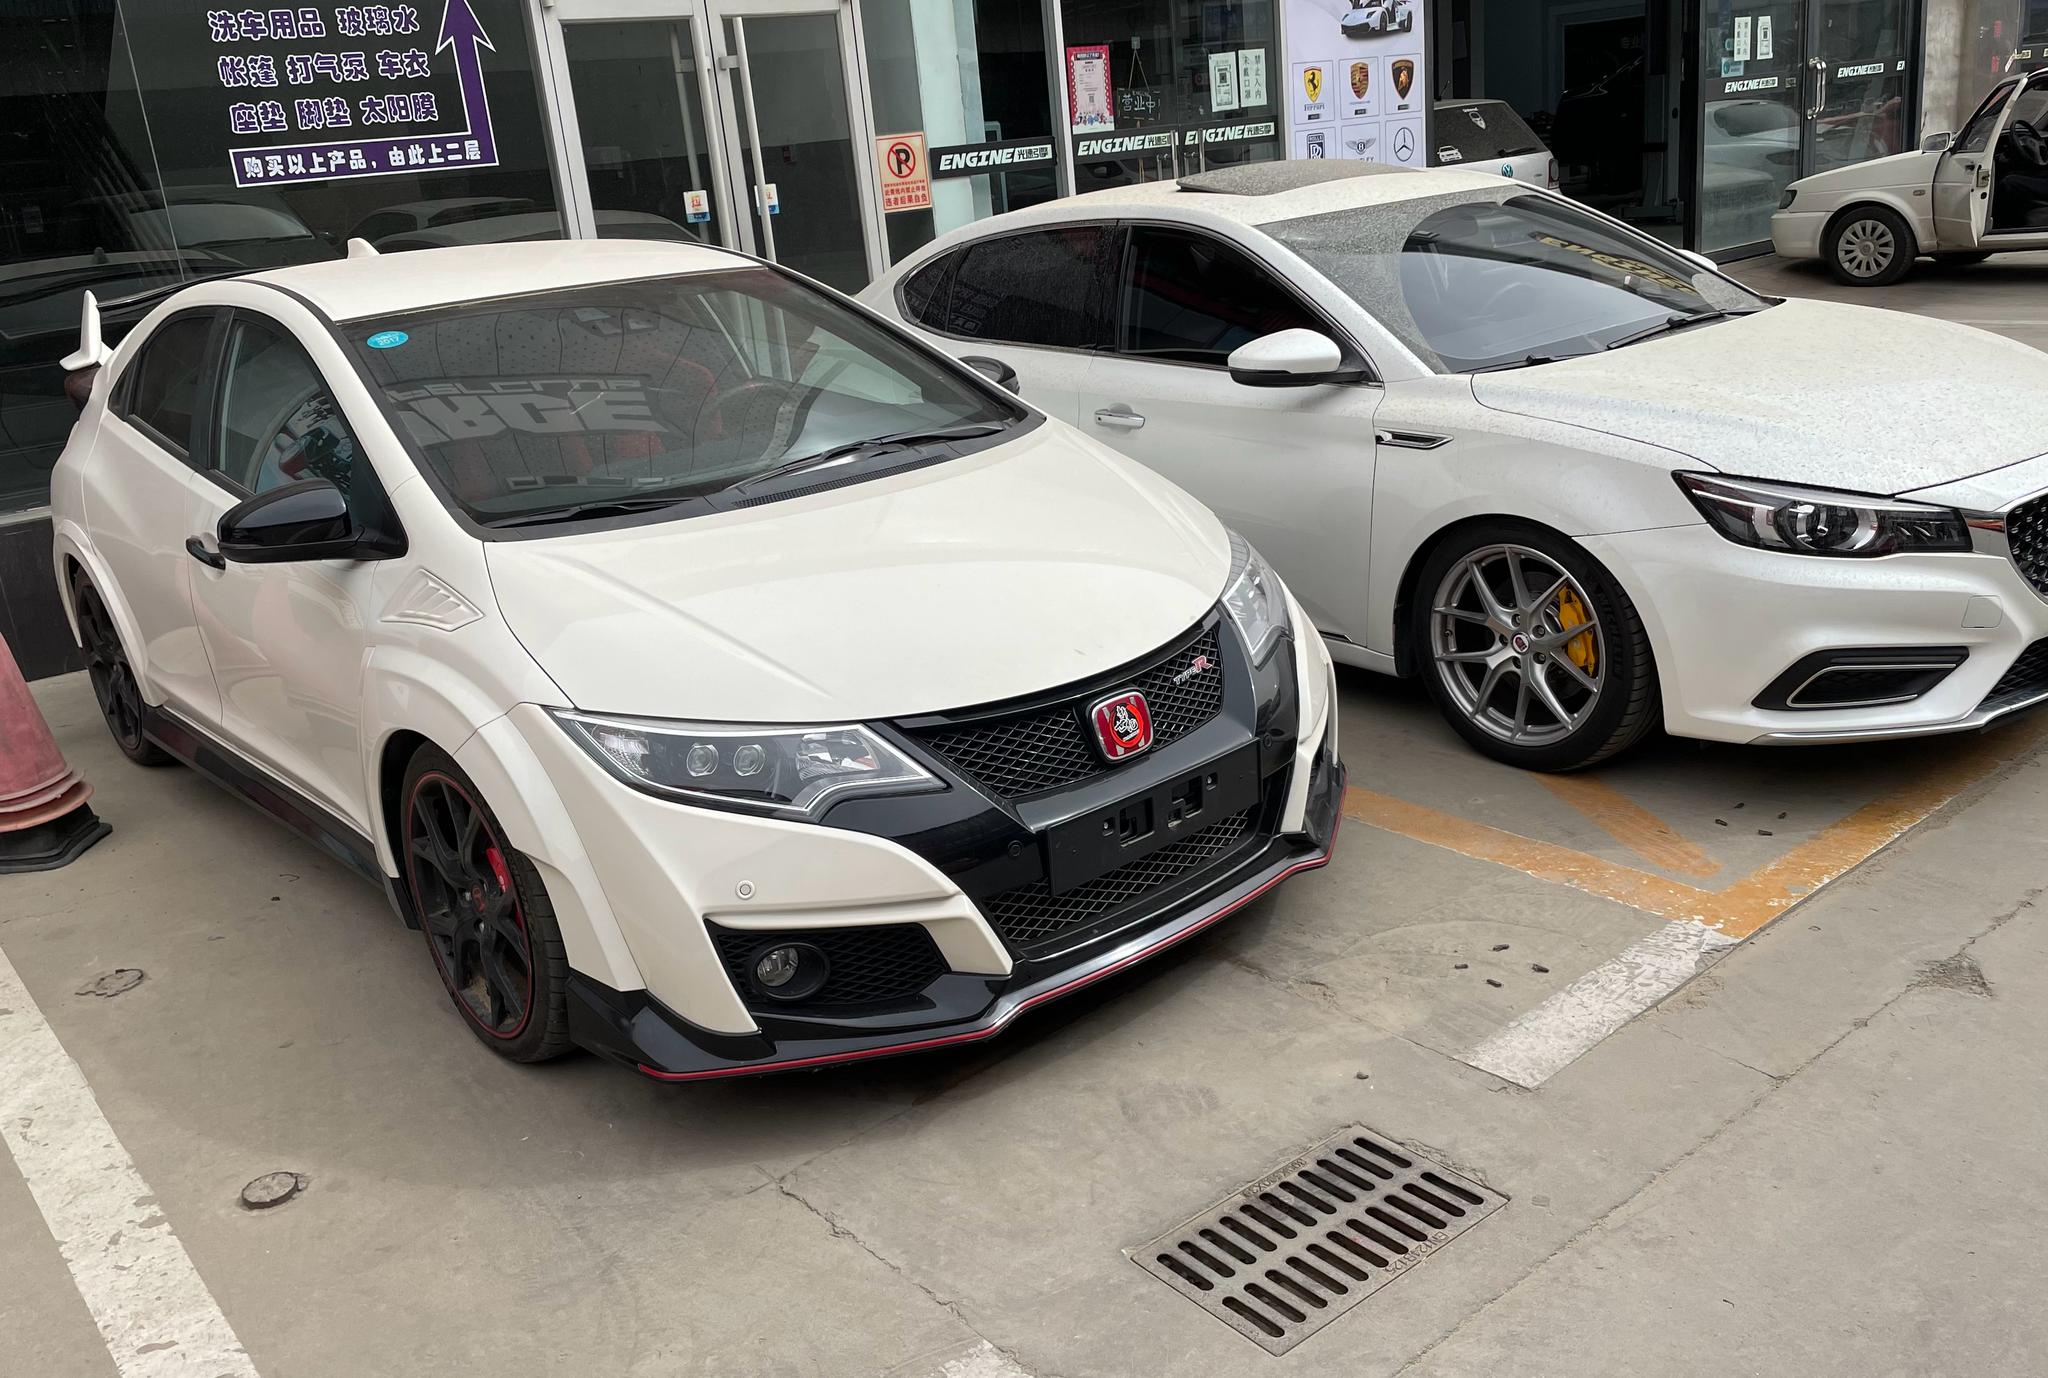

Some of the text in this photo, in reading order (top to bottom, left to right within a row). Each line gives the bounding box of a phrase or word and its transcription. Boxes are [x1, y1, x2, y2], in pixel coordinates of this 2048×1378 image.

[207, 5, 420, 42] 洗车用品 玻璃水
[218, 48, 430, 87] 帐篷 打气泵 车衣
[1838, 65, 1869, 78] ENGINE
[1724, 79, 1761, 93] ENGINE
[229, 92, 439, 134] 座垫 脚垫 太阳膜
[1122, 93, 1156, 114] 营业中
[1078, 135, 1146, 156] ENGINE
[1185, 125, 1245, 146] ENGINE
[243, 139, 481, 179] 购买以上产品，由此上二层
[939, 147, 1014, 171] ENGINE
[377, 336, 399, 346] 2017
[1173, 655, 1213, 686] TYPE R
